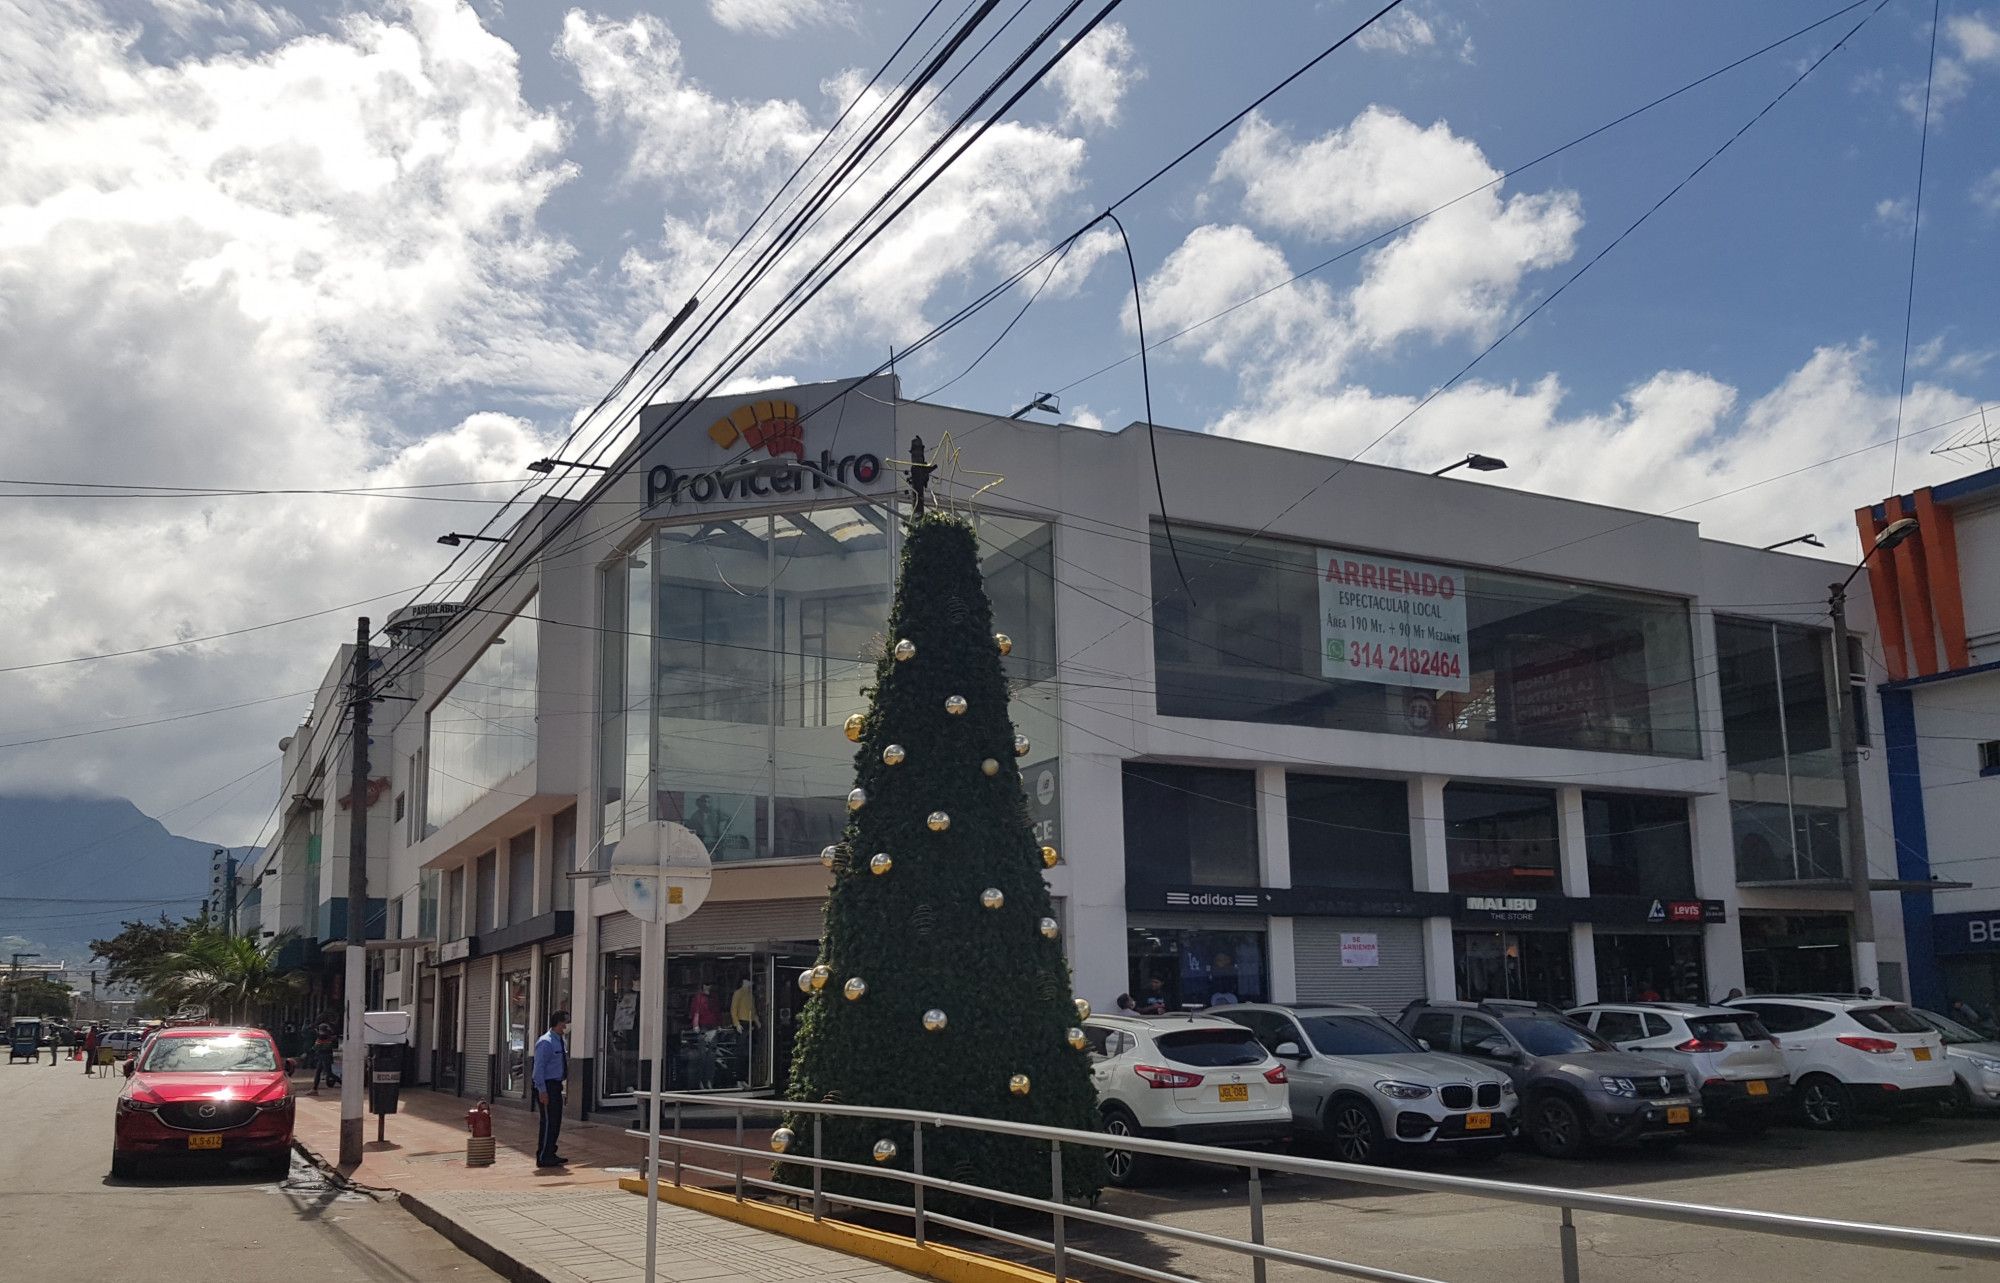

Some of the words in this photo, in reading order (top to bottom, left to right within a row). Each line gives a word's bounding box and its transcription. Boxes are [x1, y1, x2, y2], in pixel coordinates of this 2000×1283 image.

[647, 449, 880, 508] Provicentro
[1326, 558, 1455, 600] ARRIENDO
[1339, 591, 1410, 615] ESPECTACULAR
[1413, 600, 1442, 619] LOCAL
[1351, 615, 1368, 632] 190
[1399, 622, 1411, 638] 90
[1350, 640, 1384, 670] 314
[1388, 645, 1461, 679] 2182464
[1190, 893, 1234, 906] adidas
[1466, 897, 1537, 912] MALIBU
[1490, 912, 1506, 920] THE
[1507, 913, 1534, 921] STORE
